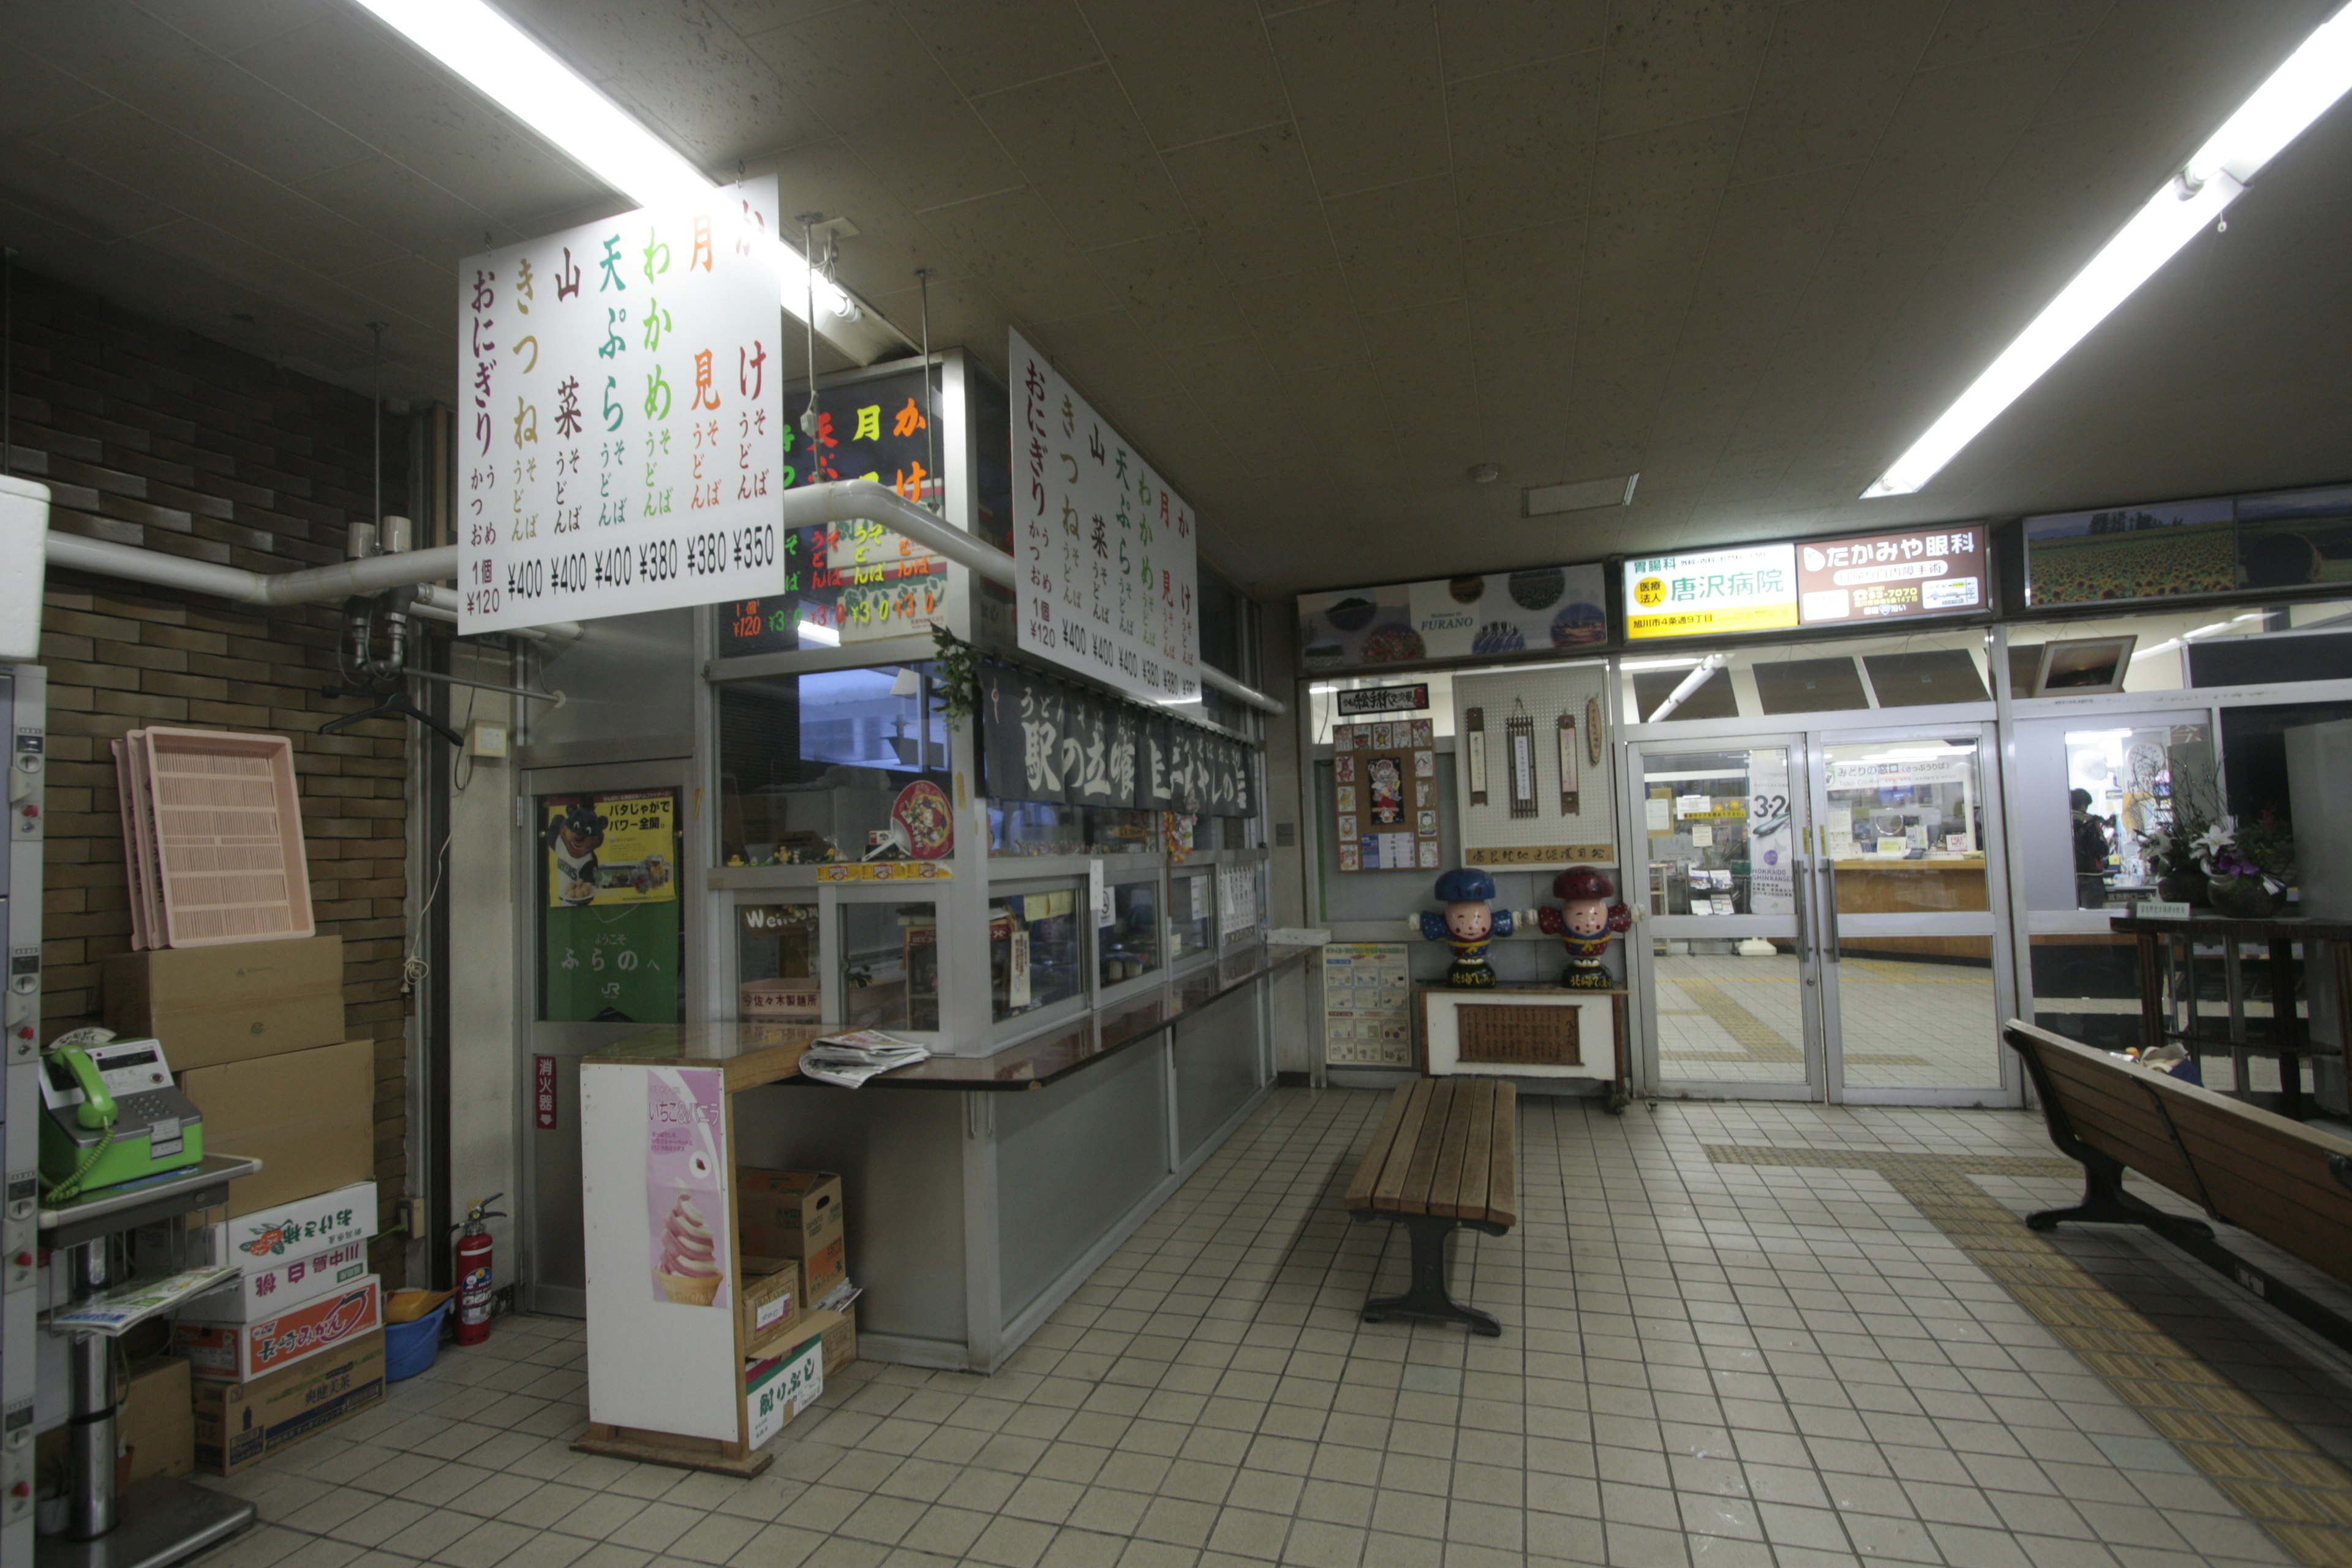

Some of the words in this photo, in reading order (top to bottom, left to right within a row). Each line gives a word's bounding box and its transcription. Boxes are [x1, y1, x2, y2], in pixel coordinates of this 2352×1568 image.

[690, 213, 720, 411] 月見
[735, 199, 766, 401] かけ
[554, 247, 582, 440] 山菜
[598, 233, 626, 432] 天ぷら
[643, 226, 671, 422] わかめ
[471, 270, 497, 457] おにぎり
[512, 258, 538, 451] きつね
[1025, 359, 1046, 516] おにぎり
[1060, 394, 1079, 541] きつね
[1088, 423, 1108, 559] 山菜
[1116, 447, 1131, 575] 天ぷら
[733, 524, 774, 570] ¥350
[1139, 470, 1154, 590] わかめ
[1160, 491, 1173, 608] 月見
[1826, 532, 1974, 567] たかみや眼科
[472, 558, 492, 586] 1個
[551, 552, 587, 594] ¥400
[595, 545, 631, 588] ¥400
[639, 538, 677, 582] ¥380
[687, 531, 726, 576] ¥380
[1634, 557, 1676, 573] 胃腸科
[508, 559, 543, 601] ¥400
[1640, 581, 1661, 592] 医療
[1640, 594, 1661, 603] 法人
[1671, 568, 1784, 602] 唐沢病院
[466, 587, 500, 616] ¥120
[1634, 614, 1713, 628] 旭川市4条通9丁目
[733, 616, 761, 637] ¥120
[1030, 620, 1056, 649] ¥120
[1063, 619, 1086, 656] ¥400
[1422, 617, 1473, 631] FURANO
[1093, 633, 1114, 668] ¥400
[1119, 646, 1137, 678] ¥400
[609, 801, 671, 816] バタじゃがで
[595, 933, 627, 946] ようこそ
[601, 982, 620, 995] JR
[538, 1057, 553, 1111] 消火器
[283, 1208, 352, 1244] おけさ柿
[258, 1313, 343, 1362] 長崎みかん
[306, 1374, 352, 1406] 爽健美茶
